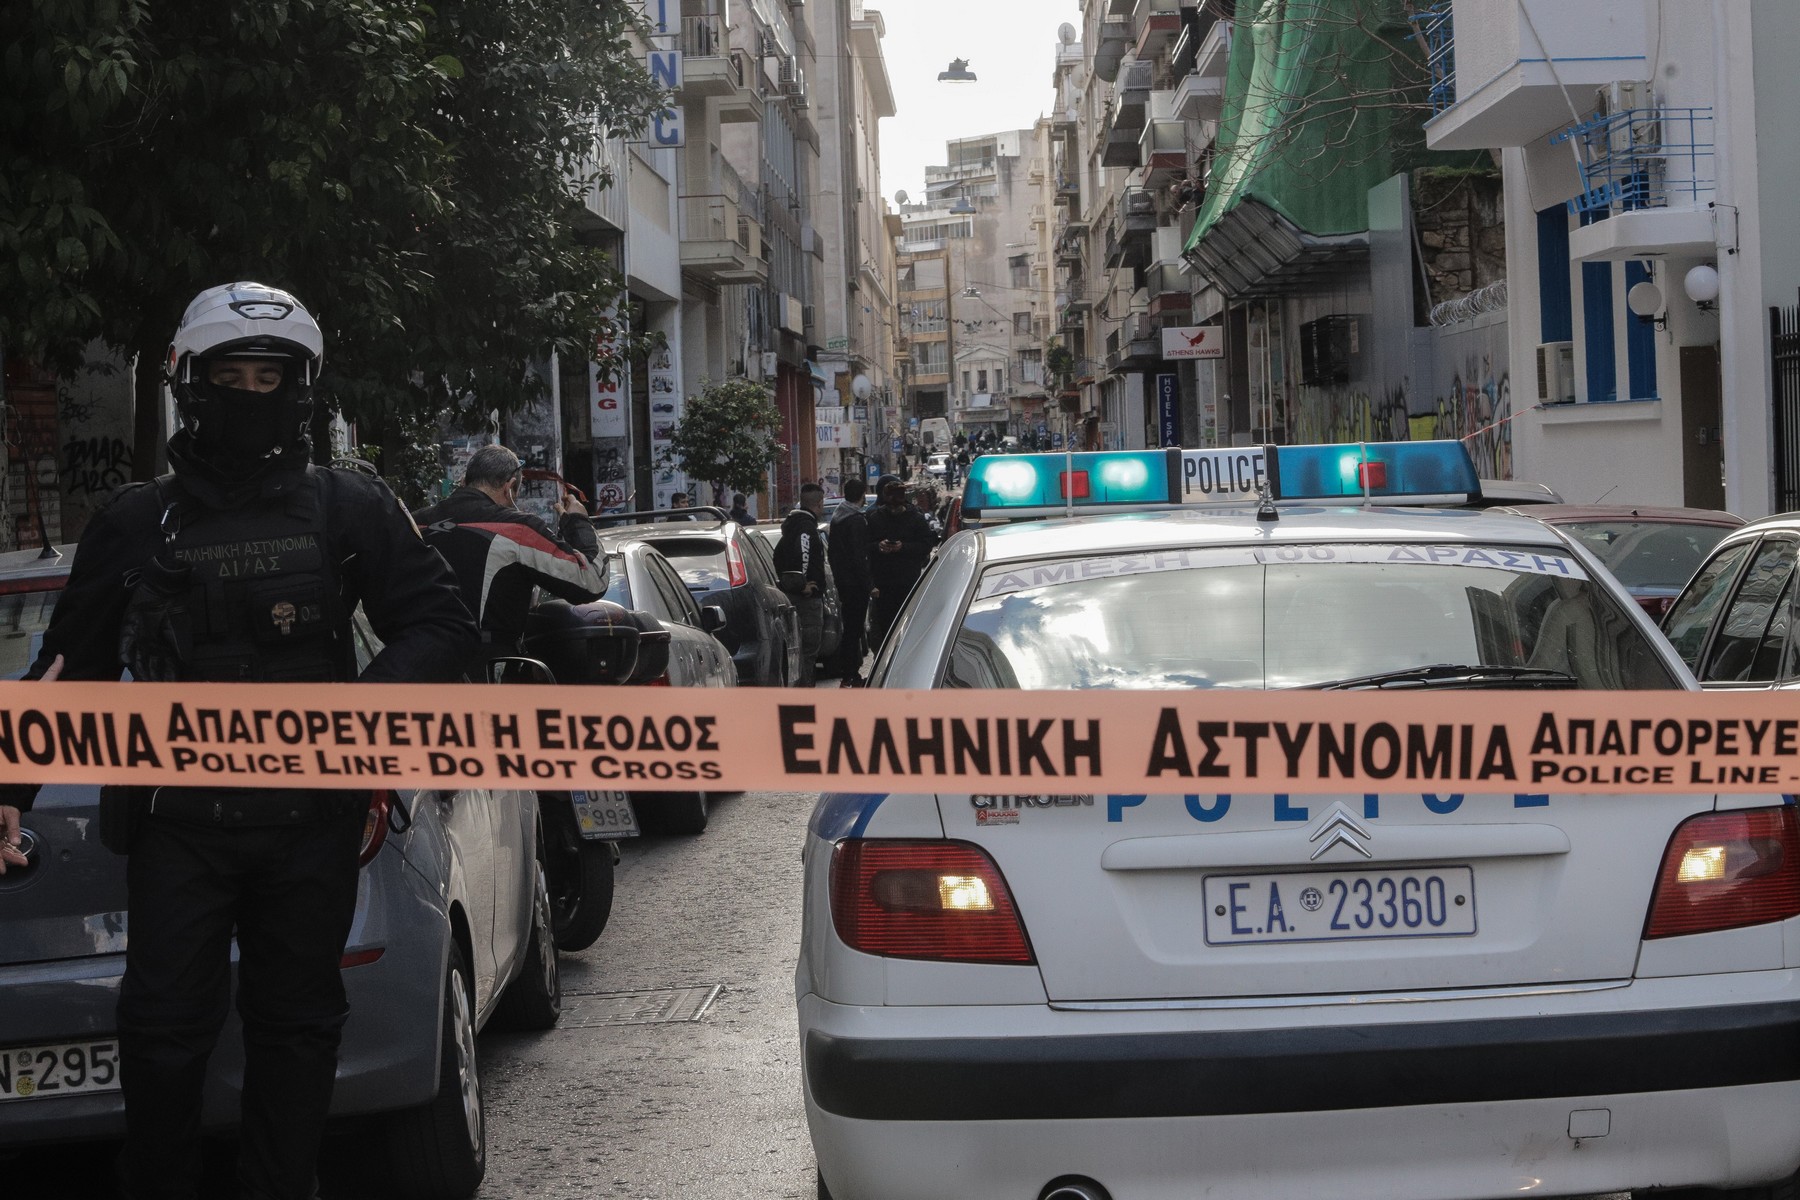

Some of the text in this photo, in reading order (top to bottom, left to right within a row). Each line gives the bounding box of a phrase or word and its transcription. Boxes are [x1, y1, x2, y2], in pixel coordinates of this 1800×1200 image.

[1195, 348, 1221, 356] HAWKS
[1164, 378, 1172, 417] HOTEL
[1183, 455, 1264, 494] POLICE
[243, 535, 318, 555] ΑΣΤΥΝΟΜΙΑ
[991, 550, 1190, 595] ΑΜΕΣΗ
[1387, 546, 1570, 575] ΔΡΑΣΗ
[493, 714, 521, 749] Η
[536, 708, 720, 751] ΕΙΣΟΔΟΣ
[778, 704, 1518, 780] ΕΛΛΗΝΙΚΗ ΑΣΤΥΝΟΜΙΑ
[1529, 712, 1799, 756] ΑΠΑΓΟΡΕΥΕ
[171, 747, 304, 774] POLICE
[315, 749, 403, 776] LINE
[428, 752, 485, 777] DO
[496, 754, 578, 779] NOT
[591, 755, 724, 781] CROSS
[1531, 760, 1675, 785] POLICE
[1690, 761, 1780, 785] LINE
[593, 809, 632, 826] 993
[1328, 876, 1447, 931] 23360
